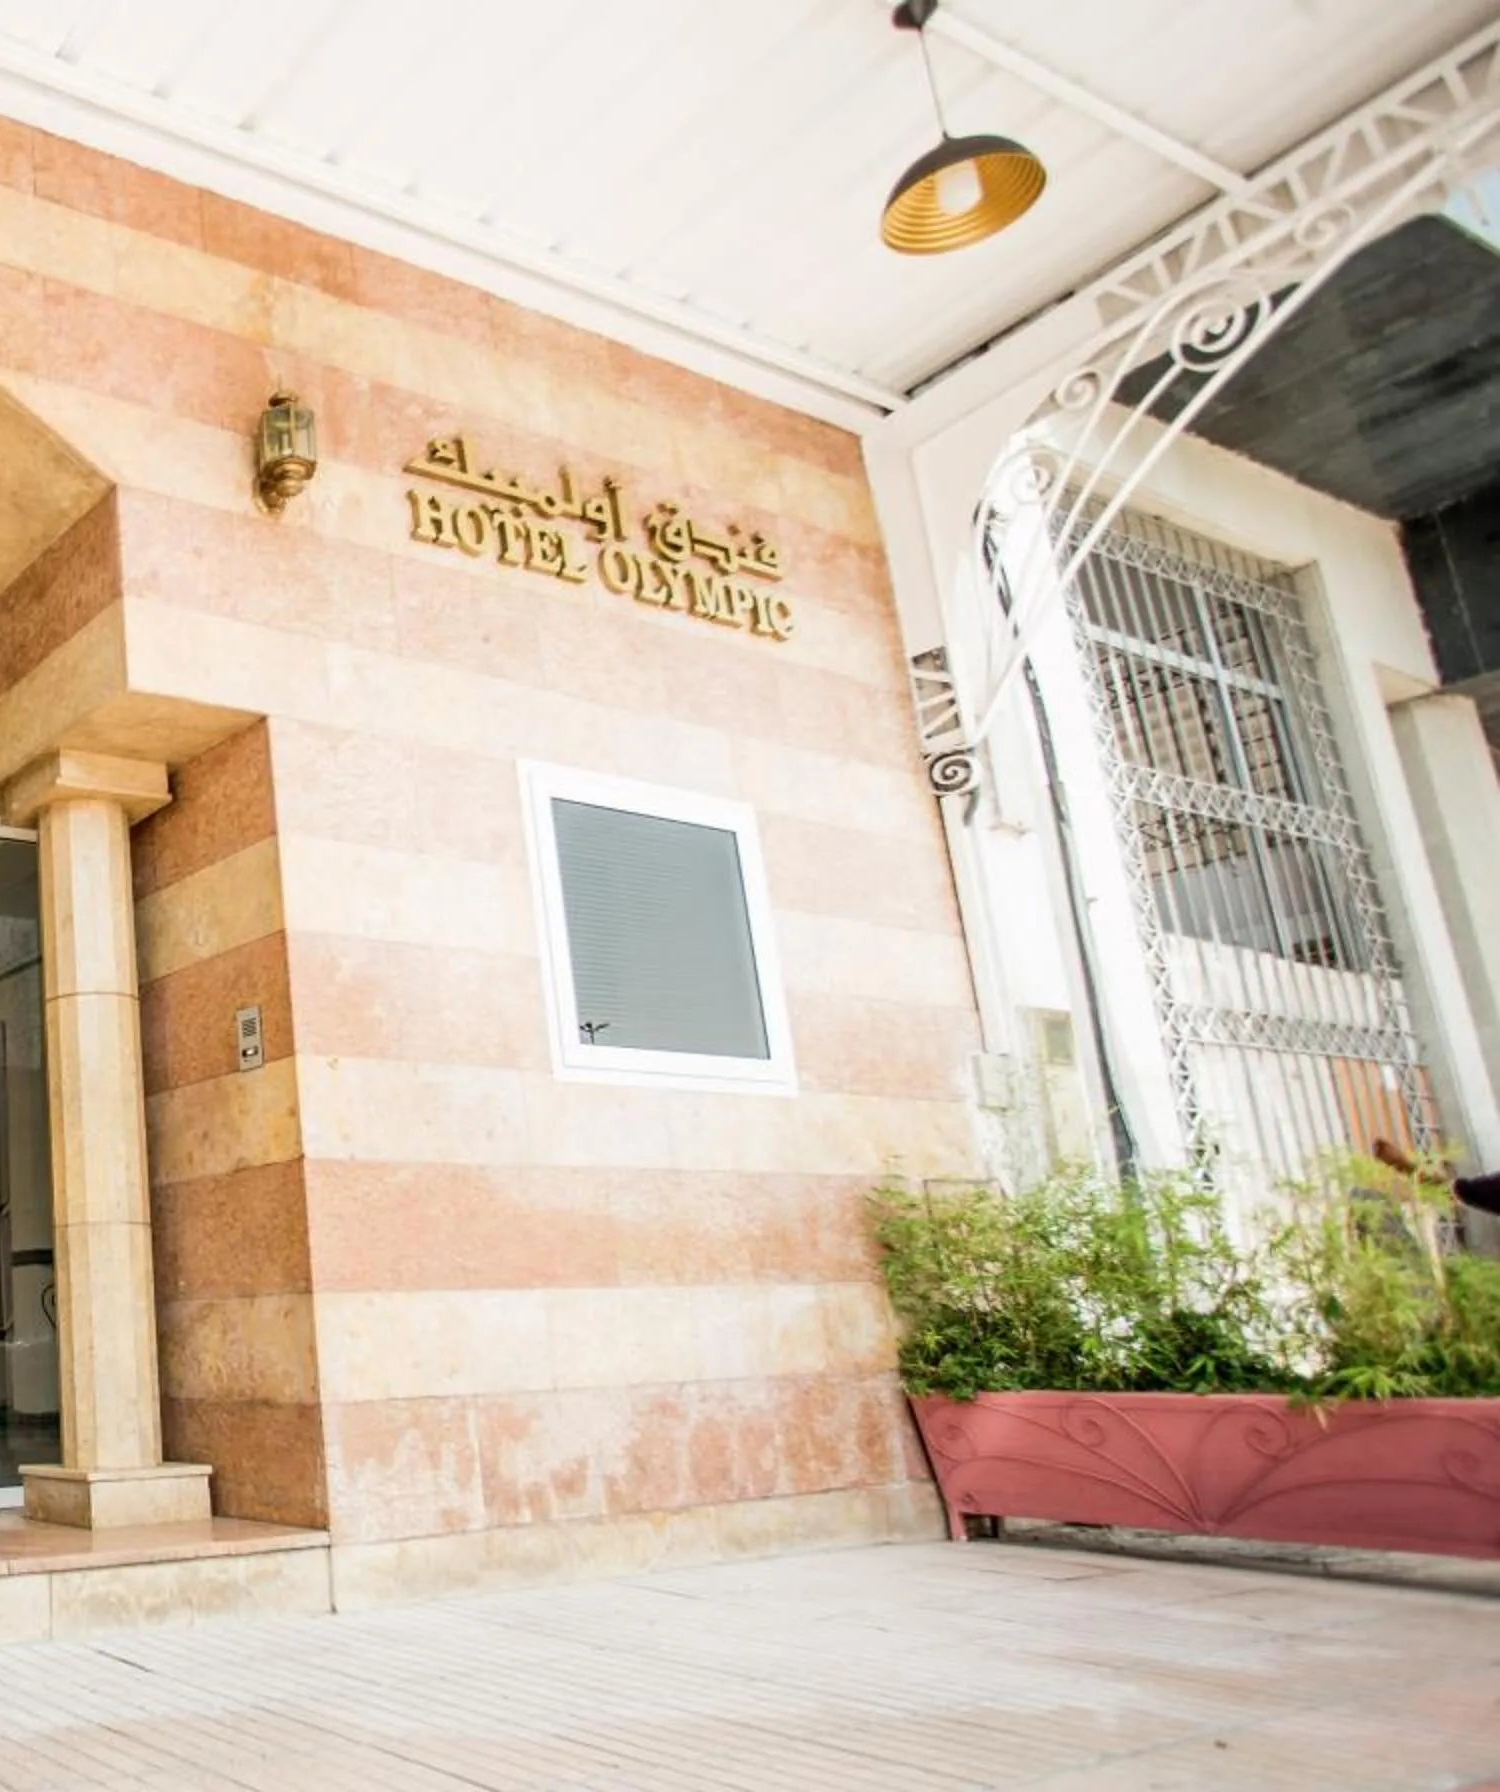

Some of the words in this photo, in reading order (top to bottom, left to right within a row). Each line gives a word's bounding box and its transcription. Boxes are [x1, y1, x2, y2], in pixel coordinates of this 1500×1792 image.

[406, 489, 589, 583] HOTEL
[598, 545, 796, 642] OLYMPIC
[643, 499, 783, 581] فندق
